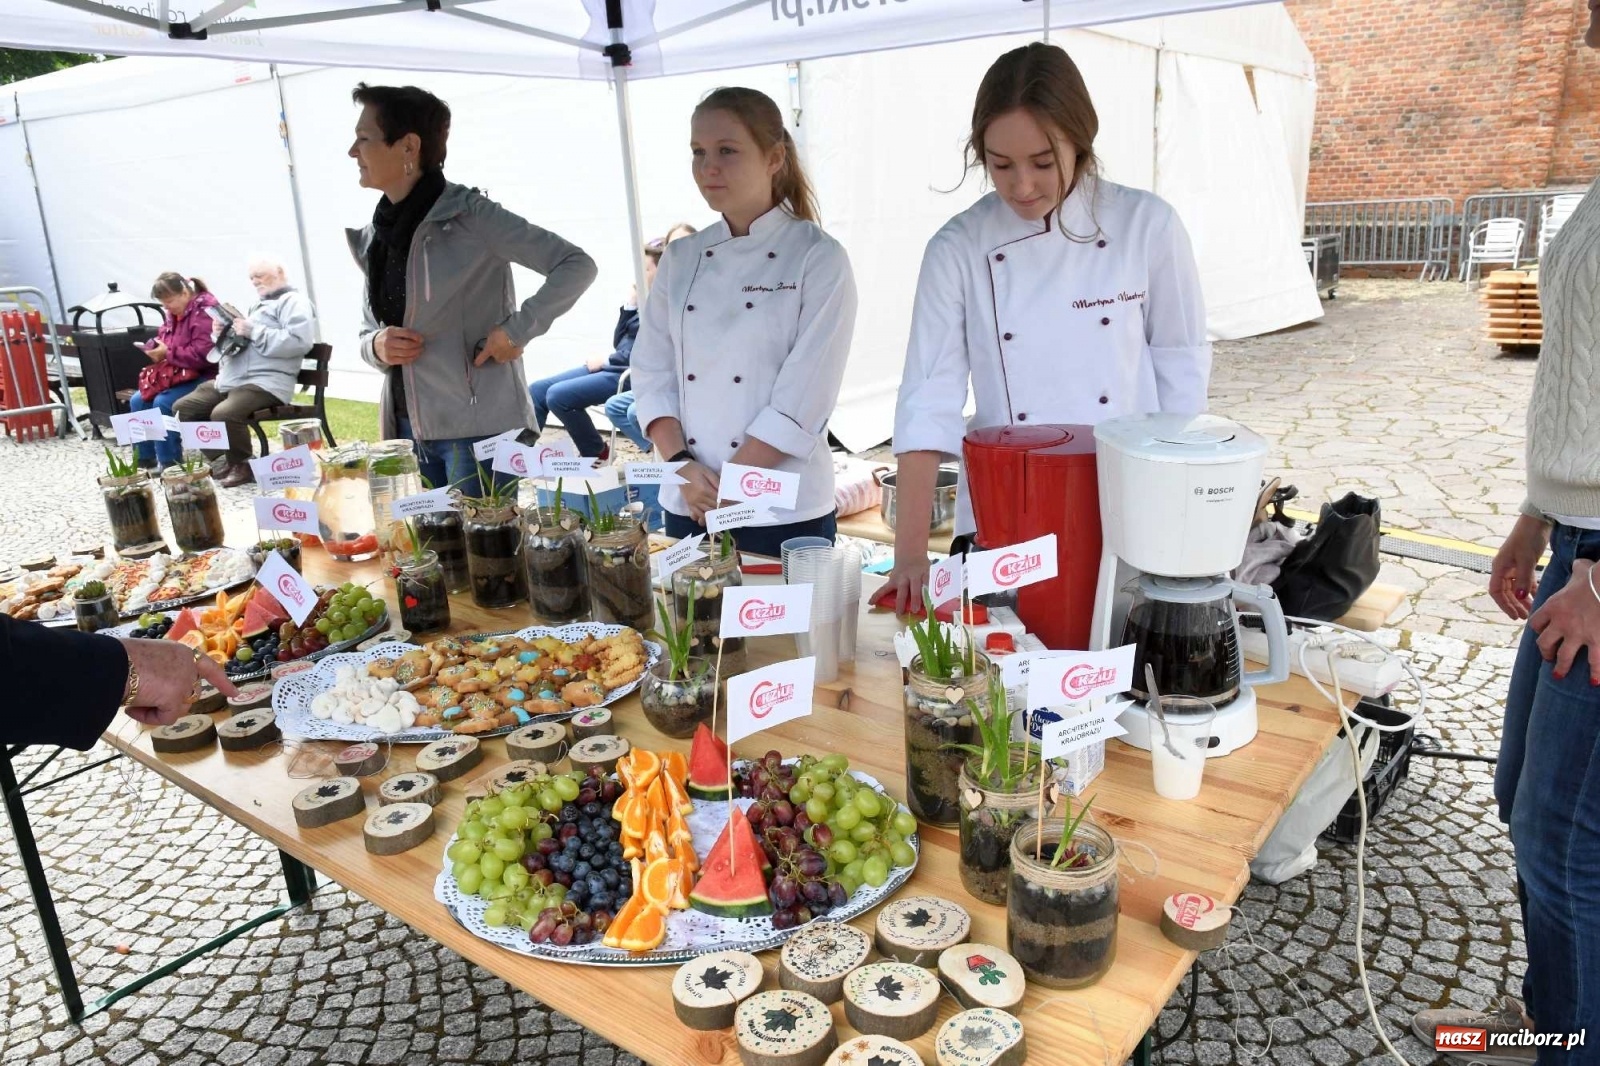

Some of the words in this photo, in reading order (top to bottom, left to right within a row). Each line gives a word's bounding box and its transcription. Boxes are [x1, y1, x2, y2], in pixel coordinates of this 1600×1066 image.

[1072, 298, 1115, 310] Martyna
[1207, 486, 1235, 495] BOSCH
[1058, 717, 1105, 738] ARCHITEKTURA
[1061, 727, 1102, 746] KRAJOBRAZU
